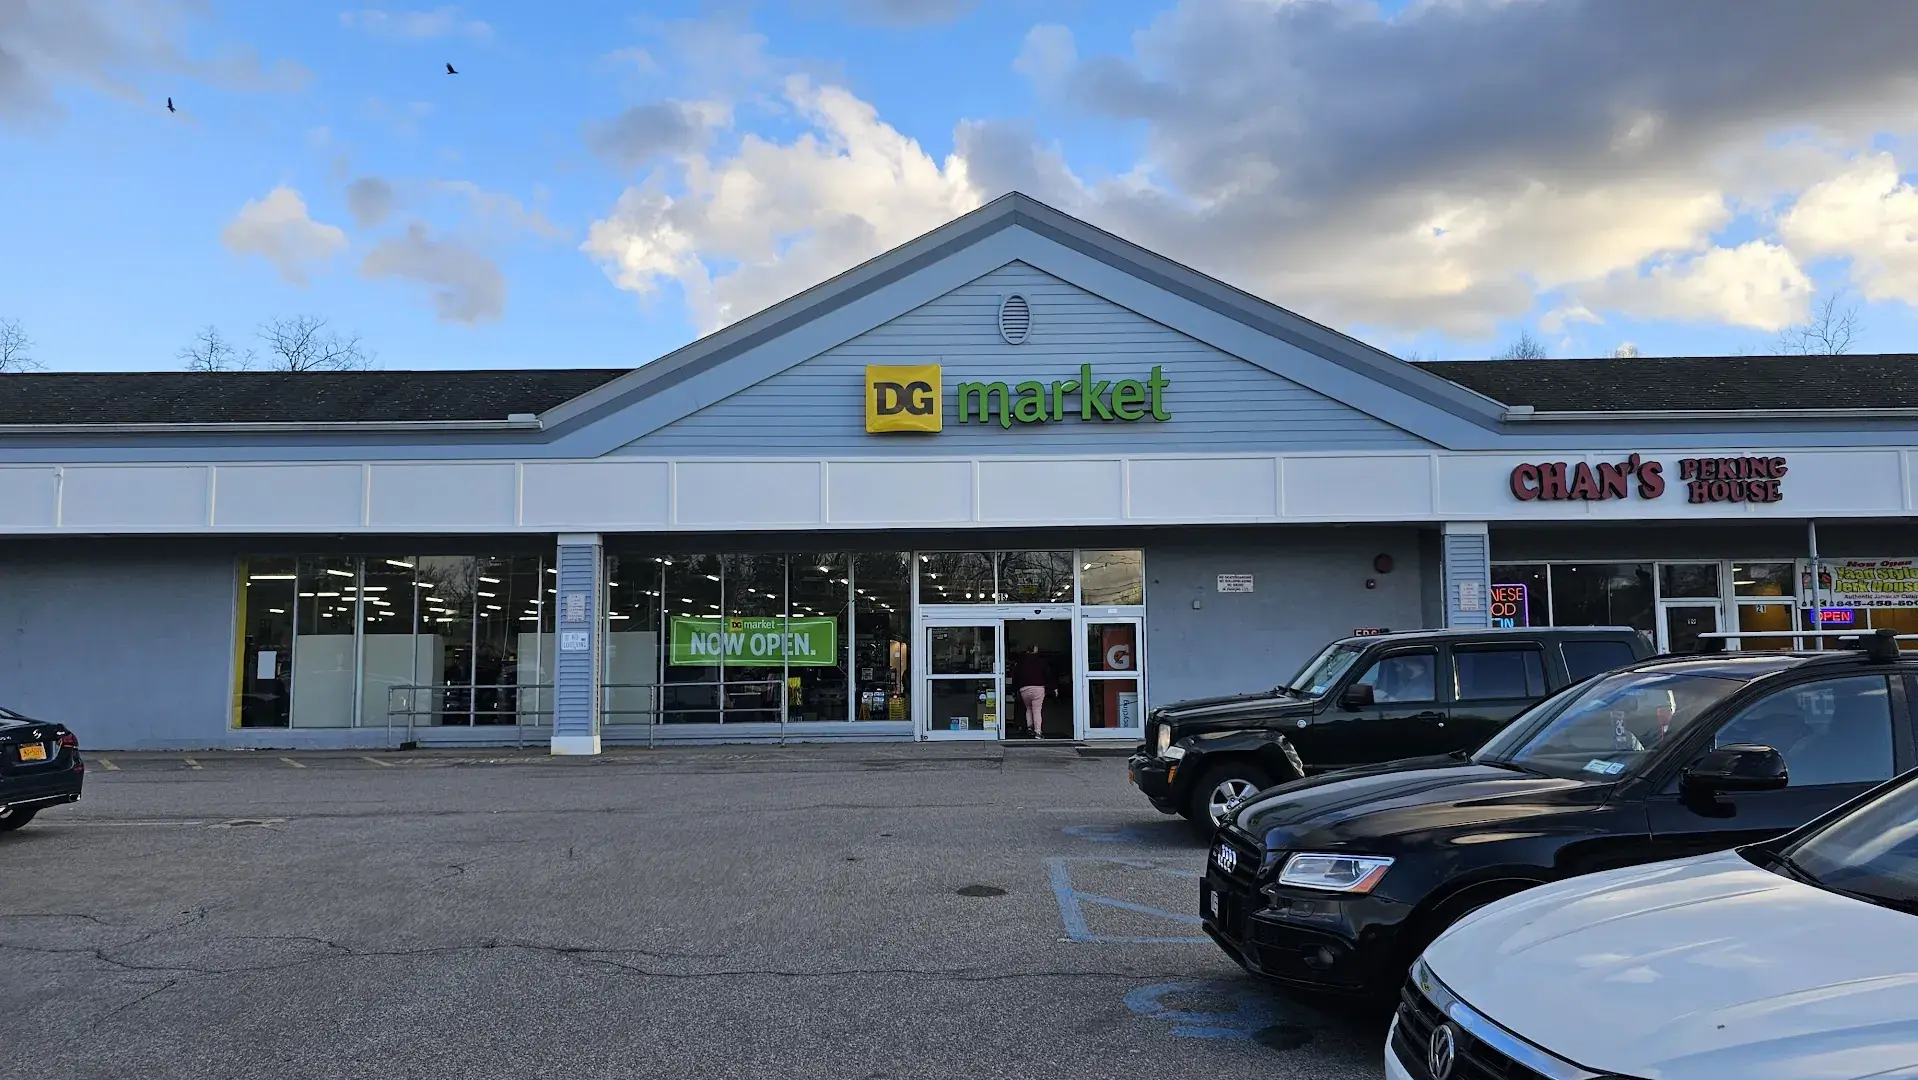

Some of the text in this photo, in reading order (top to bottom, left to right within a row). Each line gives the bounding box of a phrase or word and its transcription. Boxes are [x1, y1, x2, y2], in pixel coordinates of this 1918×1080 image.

[873, 363, 1171, 429] DG market
[1510, 453, 1788, 501] CHAN'S PEKING
[1687, 479, 1783, 504] HOUSE
[1834, 580, 1870, 592] Jerk
[1756, 605, 1766, 613] 21
[744, 619, 775, 630] market
[690, 631, 816, 656] NOW OPEN.
